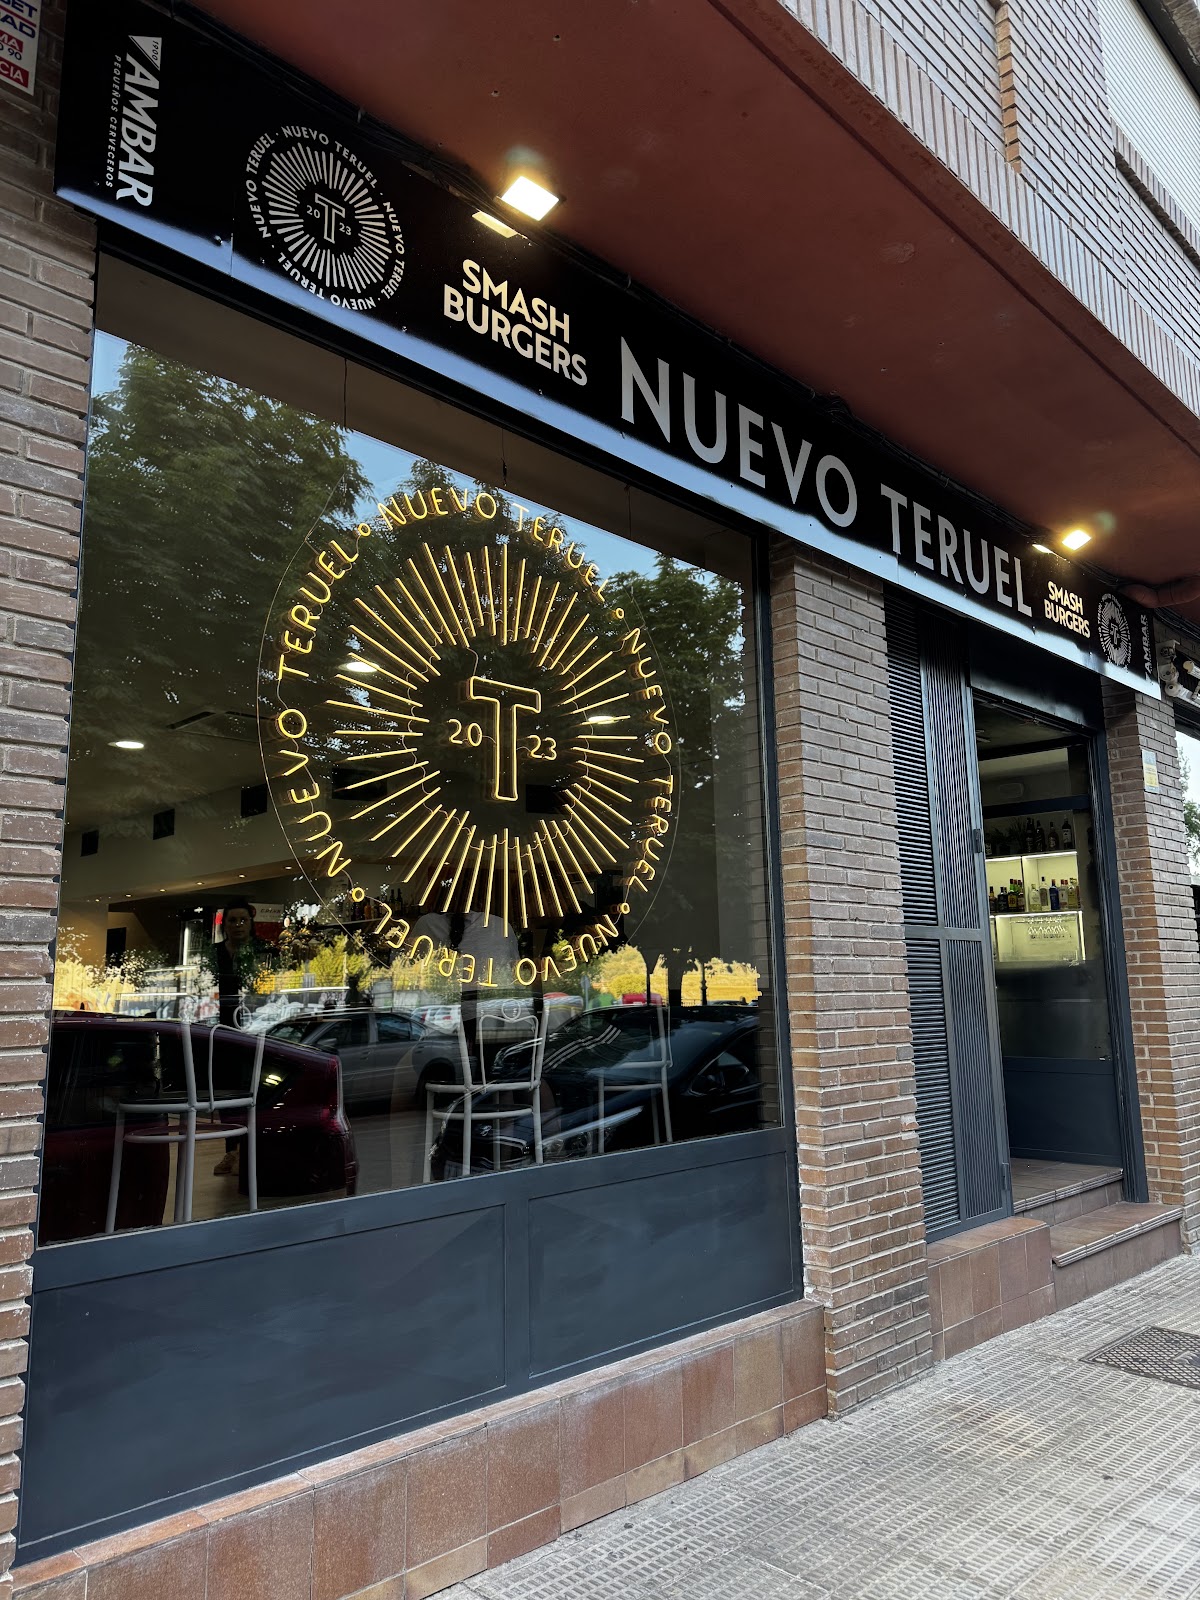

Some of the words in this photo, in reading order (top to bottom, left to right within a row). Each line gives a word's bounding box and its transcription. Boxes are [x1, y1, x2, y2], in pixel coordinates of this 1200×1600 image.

[151, 40, 159, 61] 1900
[110, 54, 122, 112] PEQUEÑOS
[105, 116, 118, 188] CERVECEROS
[115, 53, 160, 207] AMBAR
[246, 132, 276, 175] TERUEL
[281, 125, 329, 145] NUEVO
[334, 141, 378, 189] TERUEL
[245, 179, 272, 239] NUEVO
[306, 204, 321, 219] 20
[338, 222, 352, 236] 23
[314, 192, 346, 244] T
[382, 201, 405, 255] NUEVO
[277, 252, 325, 301] TERUEL
[330, 294, 377, 311] NUEVO
[380, 260, 405, 300] TERUEL
[461, 259, 570, 344] SMASH
[443, 284, 588, 386] BURGERS
[620, 336, 858, 528] NUEVO
[880, 483, 1033, 618] TERUEL
[377, 487, 498, 531] NUEVO
[511, 502, 609, 602] TERUEL
[277, 540, 359, 681] TERUEL
[1044, 599, 1090, 638] BURGERS
[1047, 580, 1083, 616] SMASH
[623, 628, 672, 755] NUEVO
[446, 718, 483, 747] 20
[526, 734, 558, 761] 23
[469, 675, 542, 802] T
[277, 708, 352, 878] NUEVO
[628, 774, 674, 893] TERUEL
[373, 903, 499, 988] TERUEL
[515, 914, 620, 986] NUEVO
